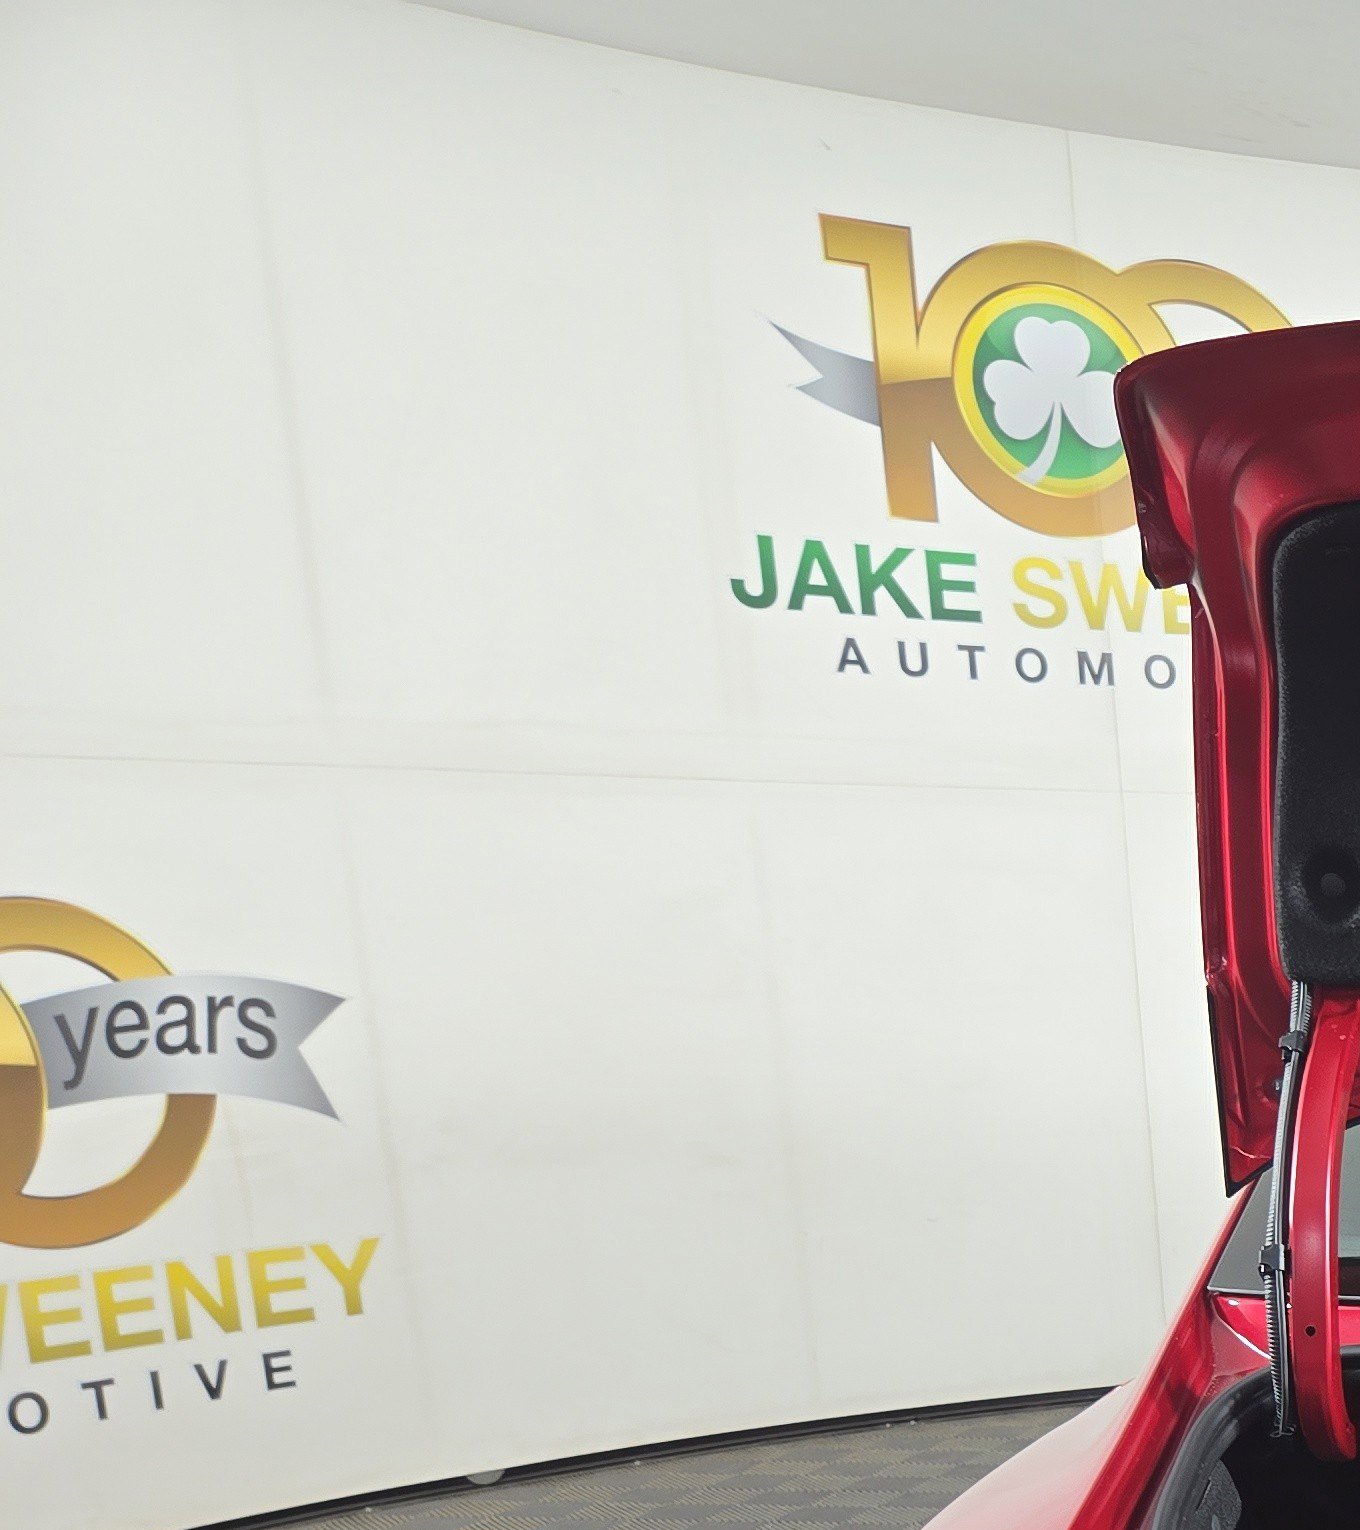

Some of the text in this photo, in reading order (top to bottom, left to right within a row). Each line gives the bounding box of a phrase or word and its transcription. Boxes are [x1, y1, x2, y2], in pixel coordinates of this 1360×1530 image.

[730, 534, 983, 625] JAKE
[836, 637, 1178, 690] AUTOMO
[53, 995, 278, 1091] years
[0, 1237, 381, 1370] EENEY
[7, 1349, 297, 1434] OTIVE
